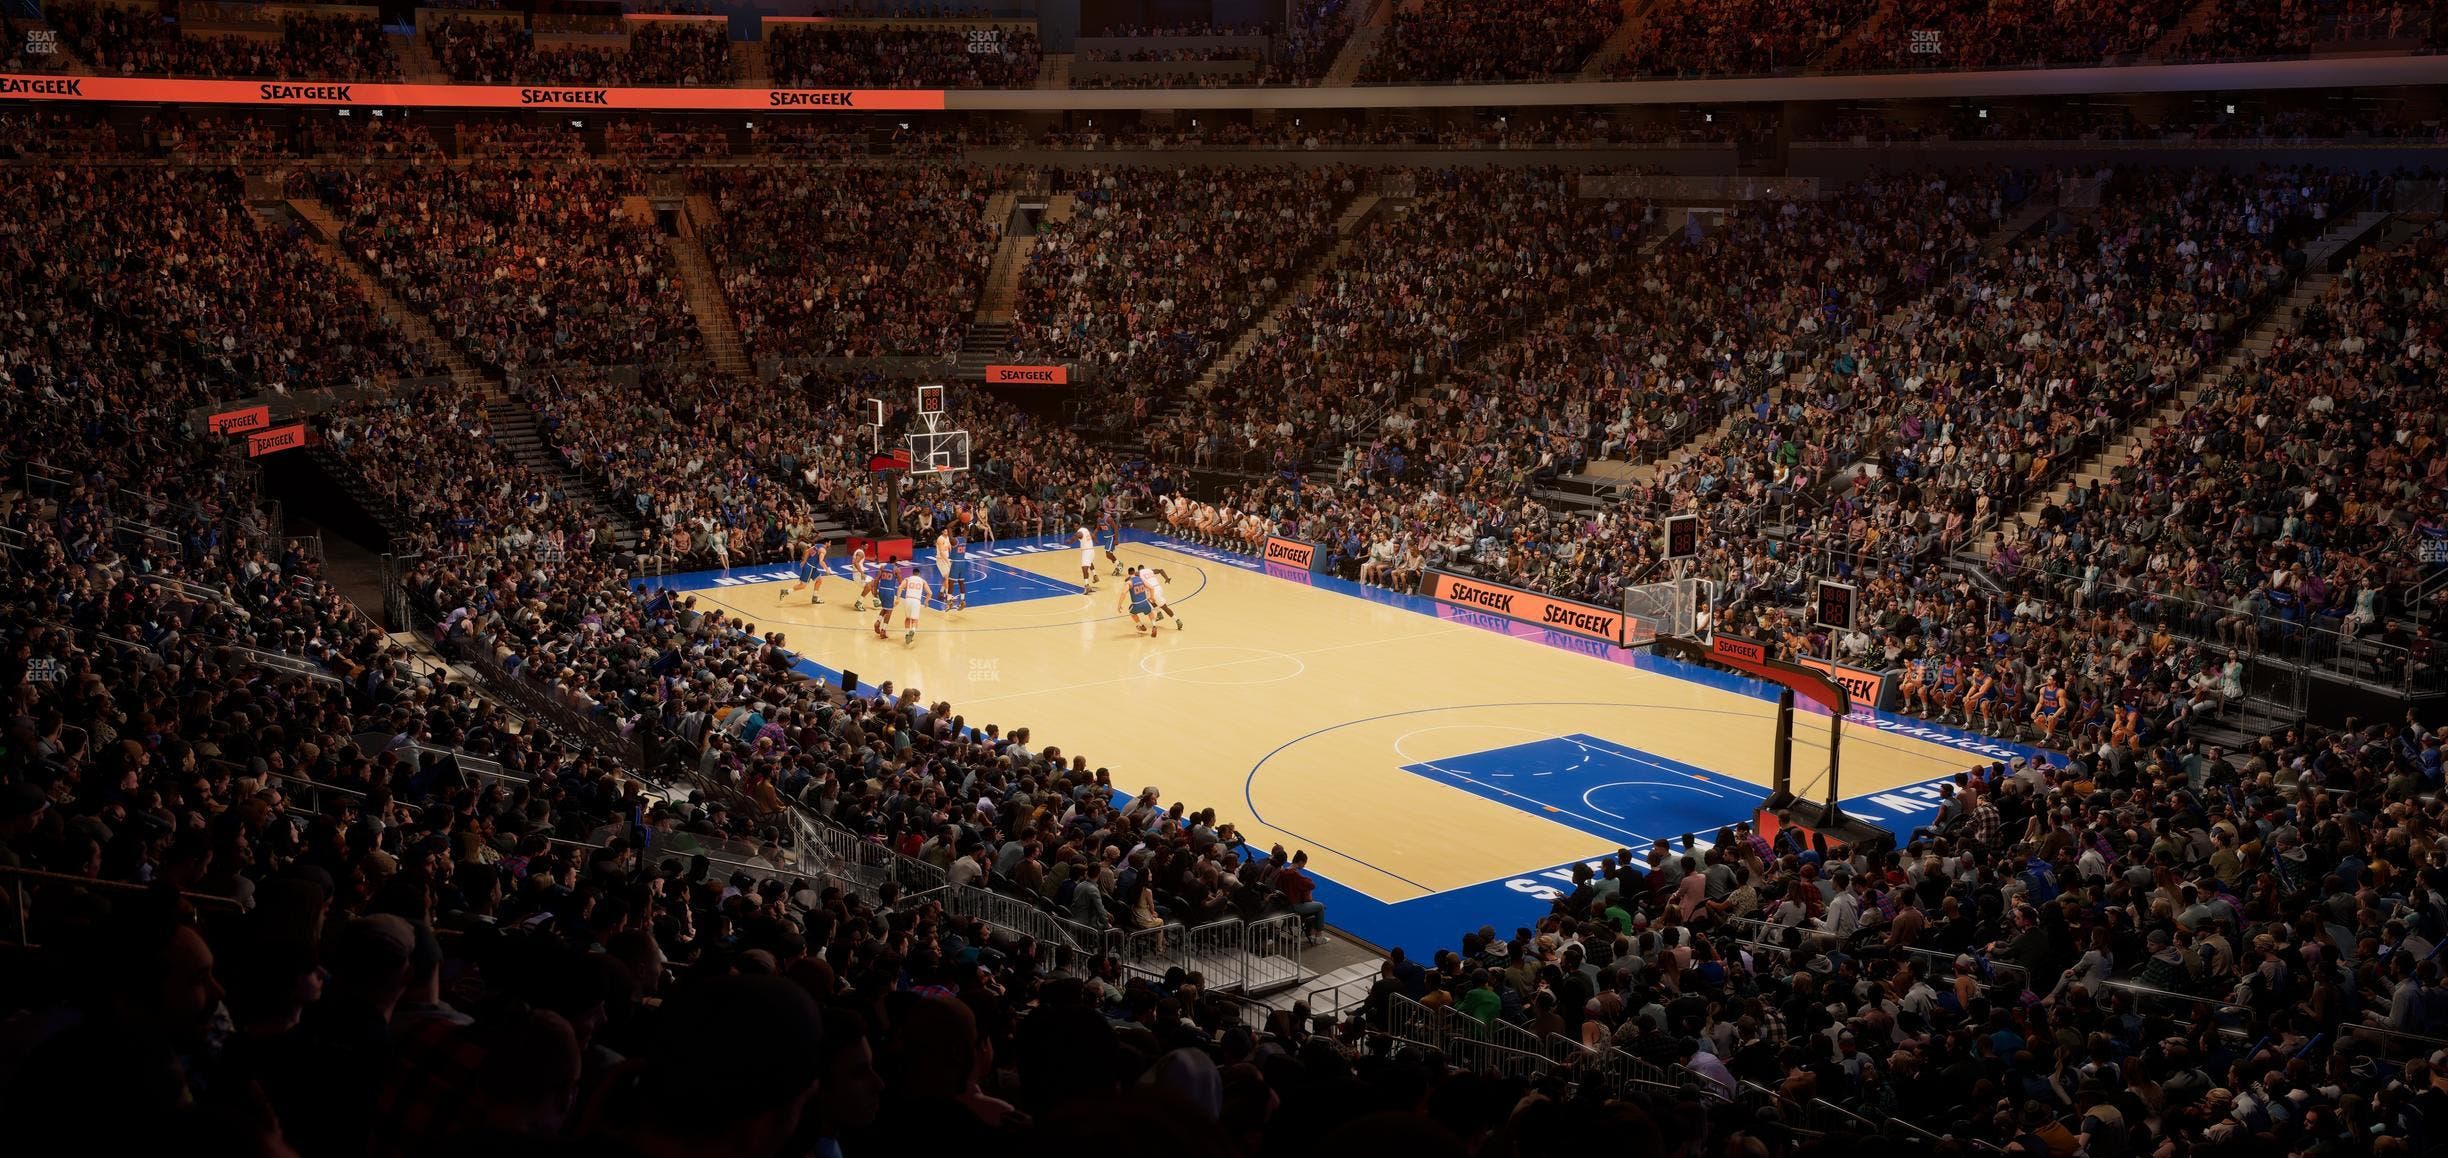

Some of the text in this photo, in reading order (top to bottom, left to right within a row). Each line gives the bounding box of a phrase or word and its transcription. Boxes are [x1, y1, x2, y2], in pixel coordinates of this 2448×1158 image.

[260, 84, 352, 102] SEATGEEK
[521, 89, 609, 105] SEATGEEK
[770, 91, 853, 106] SEATGEEK
[1000, 369, 1053, 381] SEATGEEK
[219, 412, 258, 429] SEATGEEK
[257, 431, 295, 451] SEATGEEK
[1268, 542, 1311, 566] SEATGEEK
[712, 571, 802, 586] NEW
[1450, 582, 1514, 613] SEATGEEK
[1543, 603, 1614, 637] SEATGEEK
[1719, 640, 1758, 659] SEATGEEK
